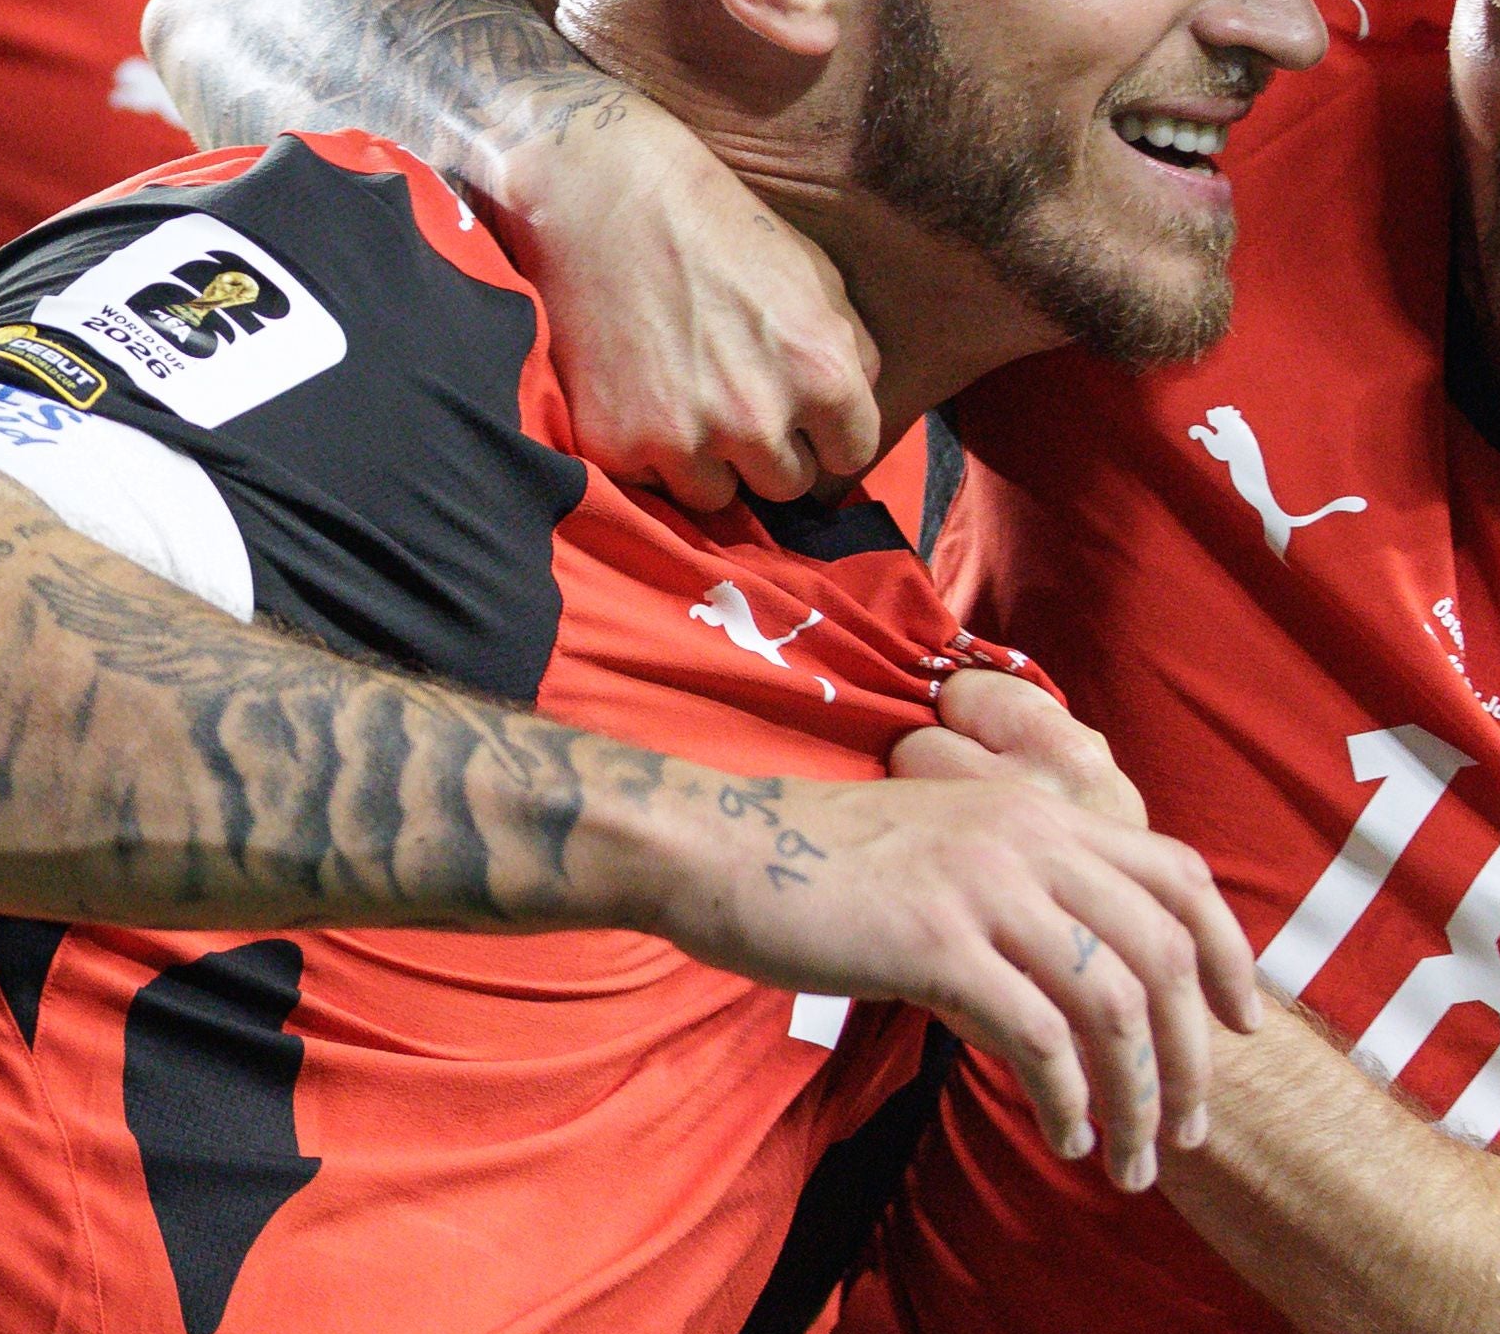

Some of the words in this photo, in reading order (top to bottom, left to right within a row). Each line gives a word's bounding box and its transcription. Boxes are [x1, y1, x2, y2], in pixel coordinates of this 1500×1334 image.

[9, 338, 97, 386] DEBUT
[81, 316, 173, 379] 2026
[101, 304, 155, 344] WORLD
[156, 345, 185, 371] CUP
[25, 353, 59, 377] WORLD
[56, 373, 77, 390] CUP
